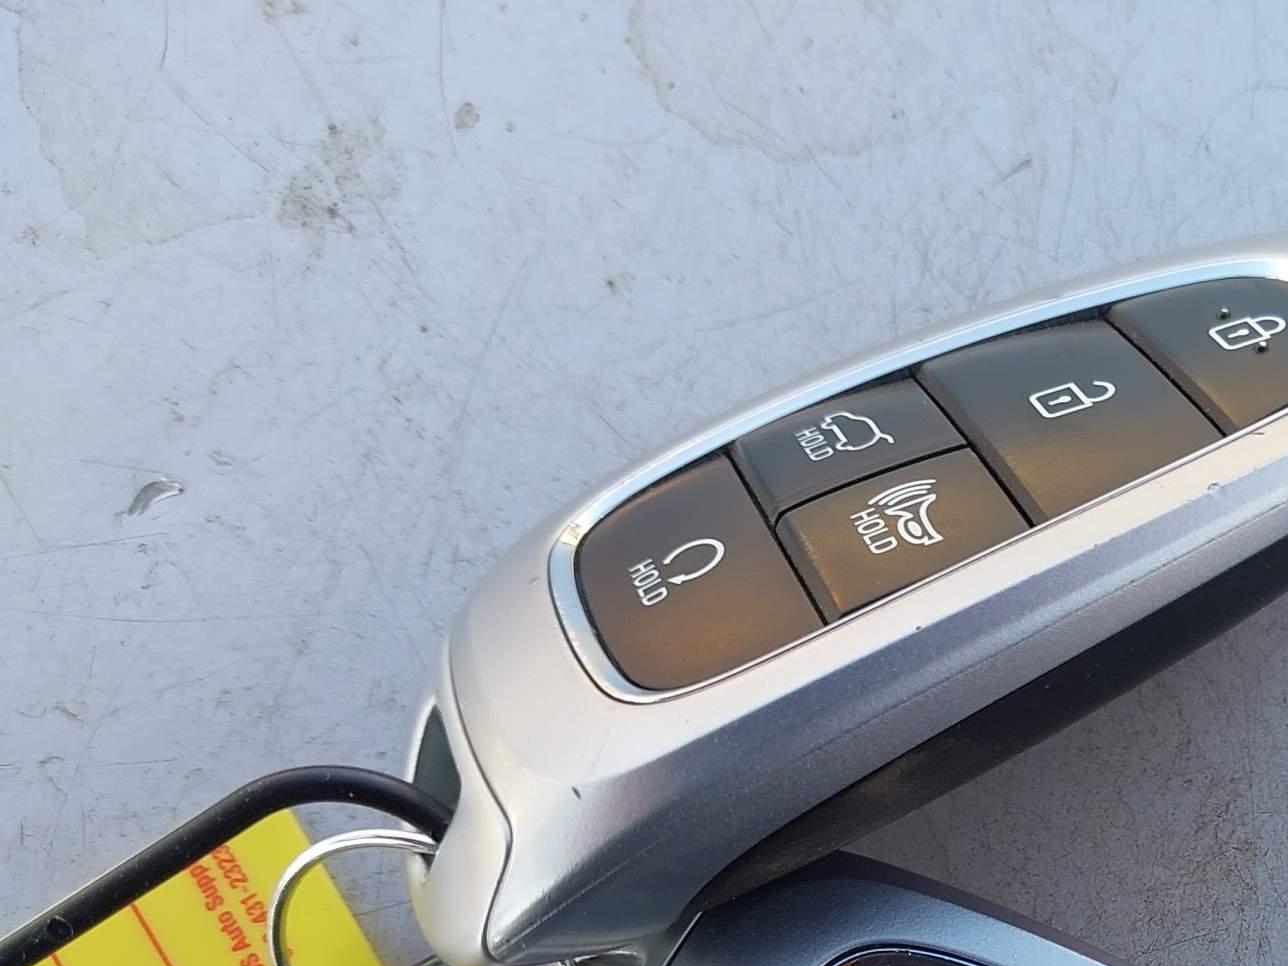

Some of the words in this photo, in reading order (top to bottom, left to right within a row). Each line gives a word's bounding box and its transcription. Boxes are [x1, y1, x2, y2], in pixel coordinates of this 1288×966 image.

[794, 425, 834, 462] HOLD
[850, 507, 898, 555] HOLD
[627, 556, 668, 607] HOLD
[190, 864, 224, 911] Supp
[218, 910, 251, 952] Auto
